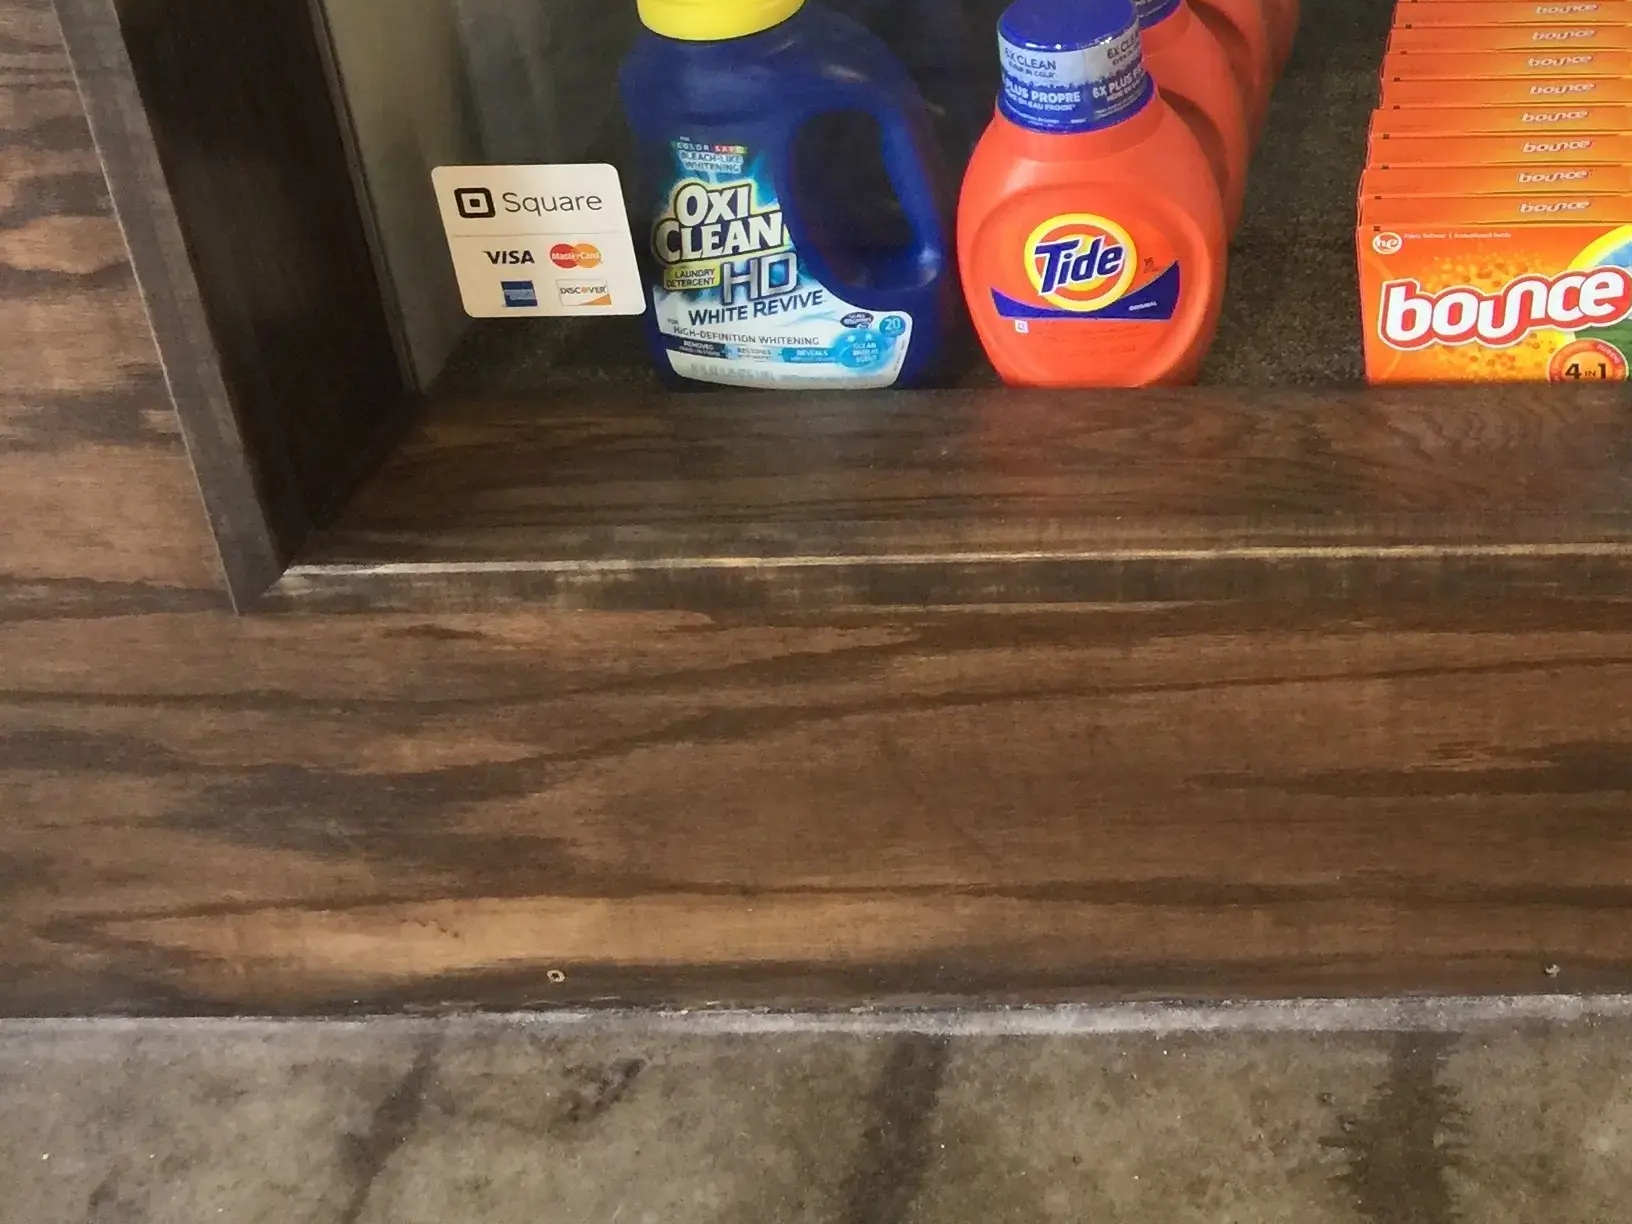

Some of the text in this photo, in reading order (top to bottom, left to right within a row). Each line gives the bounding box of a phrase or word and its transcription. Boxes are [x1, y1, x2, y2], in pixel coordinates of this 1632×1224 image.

[1535, 3, 1599, 15] bounce
[1532, 29, 1596, 41] bounce
[1016, 55, 1056, 70] CLEAN
[1528, 54, 1594, 67] bounce
[1092, 86, 1108, 99] 6X
[1108, 72, 1132, 94] PLUS
[1529, 82, 1596, 95] bounce
[1031, 90, 1082, 104] PROPRE
[1521, 110, 1590, 123] bounce
[676, 142, 709, 152] COLOR
[1522, 139, 1593, 153] bounce
[680, 150, 743, 164] BLEACH-LIKE
[684, 160, 741, 173] WHITENING
[1518, 170, 1590, 184] bounce
[502, 192, 602, 216] Square
[674, 182, 752, 227] OXI
[1520, 200, 1591, 213] bounce
[654, 210, 784, 265] CLEAN
[483, 250, 536, 264] VISA
[552, 252, 600, 262] MasterCard
[1034, 236, 1124, 295] Tide
[674, 268, 716, 279] LAUNDRY
[721, 252, 797, 305] HD
[666, 277, 716, 288] DETERGENT
[560, 286, 606, 295] DISCOVER
[688, 290, 824, 326] WHITE REVIVE
[1383, 269, 1632, 344] bounce
[884, 318, 901, 330] 20
[674, 326, 820, 346] HIGH-DEFINITION WHITENING
[1564, 363, 1607, 380] 4 IN 1
